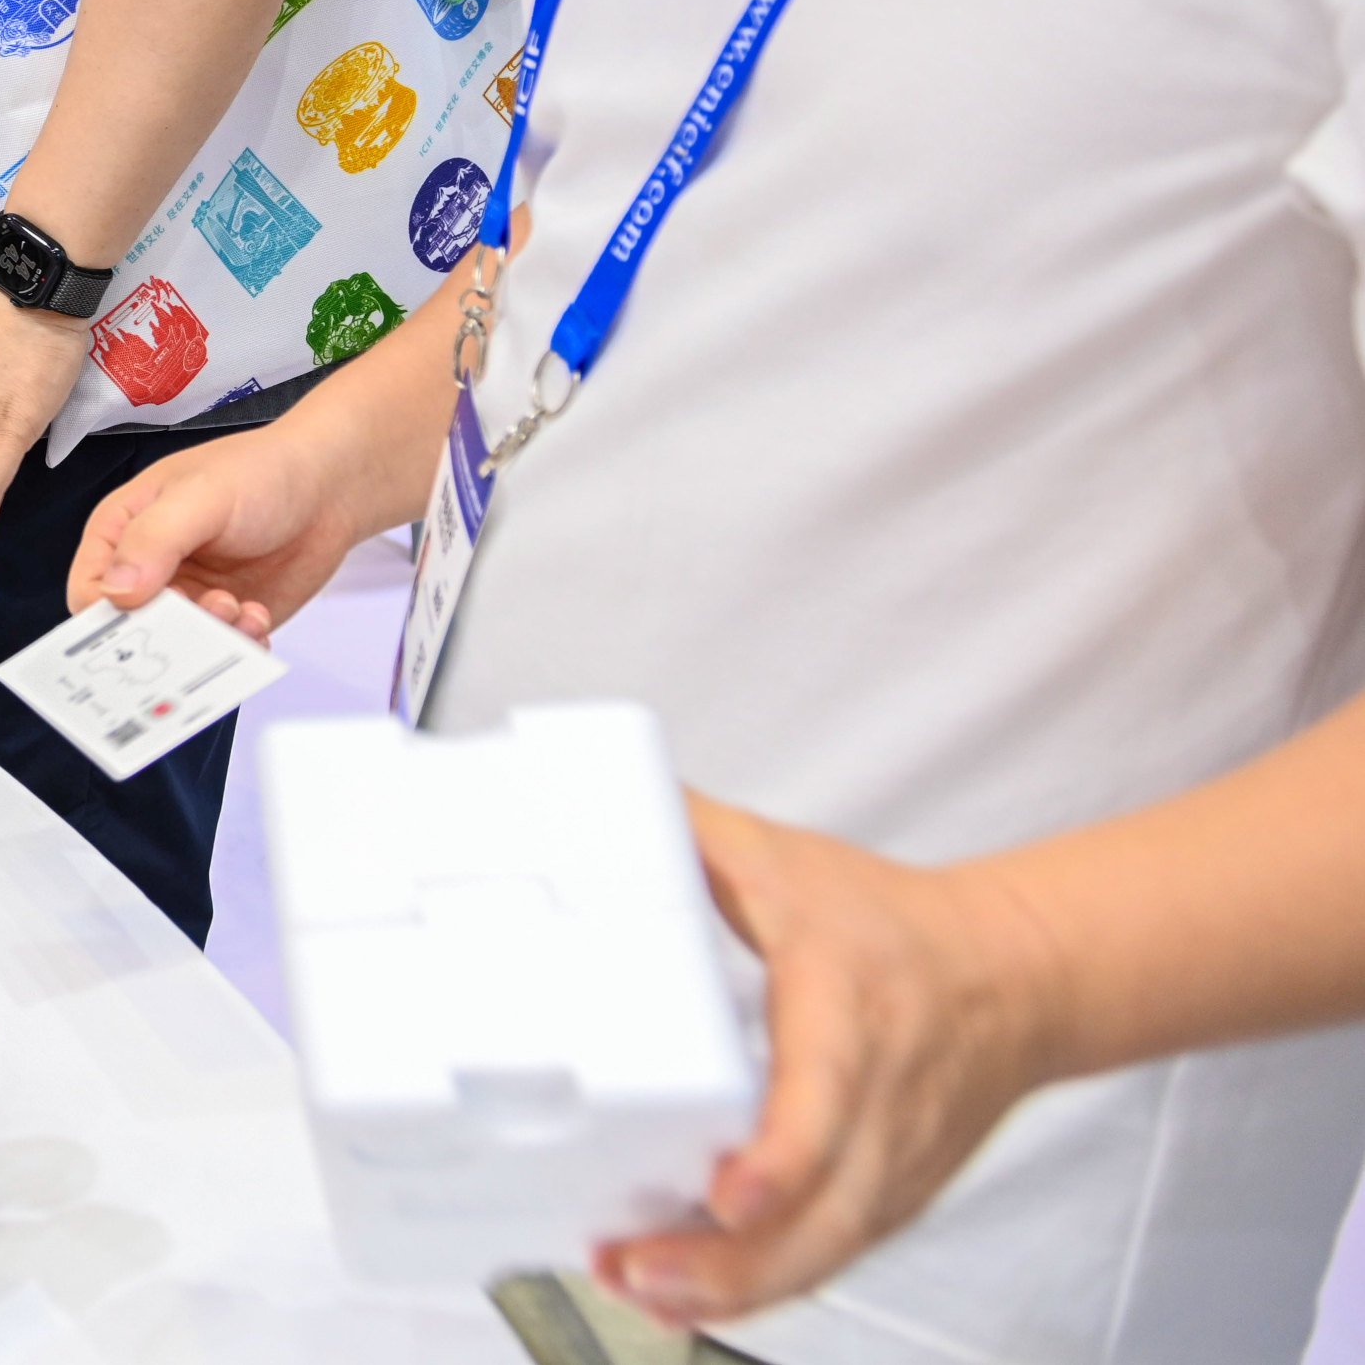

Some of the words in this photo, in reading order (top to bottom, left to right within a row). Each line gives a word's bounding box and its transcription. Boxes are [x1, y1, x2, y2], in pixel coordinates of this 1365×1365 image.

[417, 135, 435, 158] ICIF
[434, 93, 462, 133] 世界文化
[457, 40, 495, 90] 尽在文博会
[512, 28, 542, 120] ICIF
[124, 223, 167, 265] 世界文化
[164, 171, 208, 222] 尽在文博会
[12, 253, 37, 281] 14
